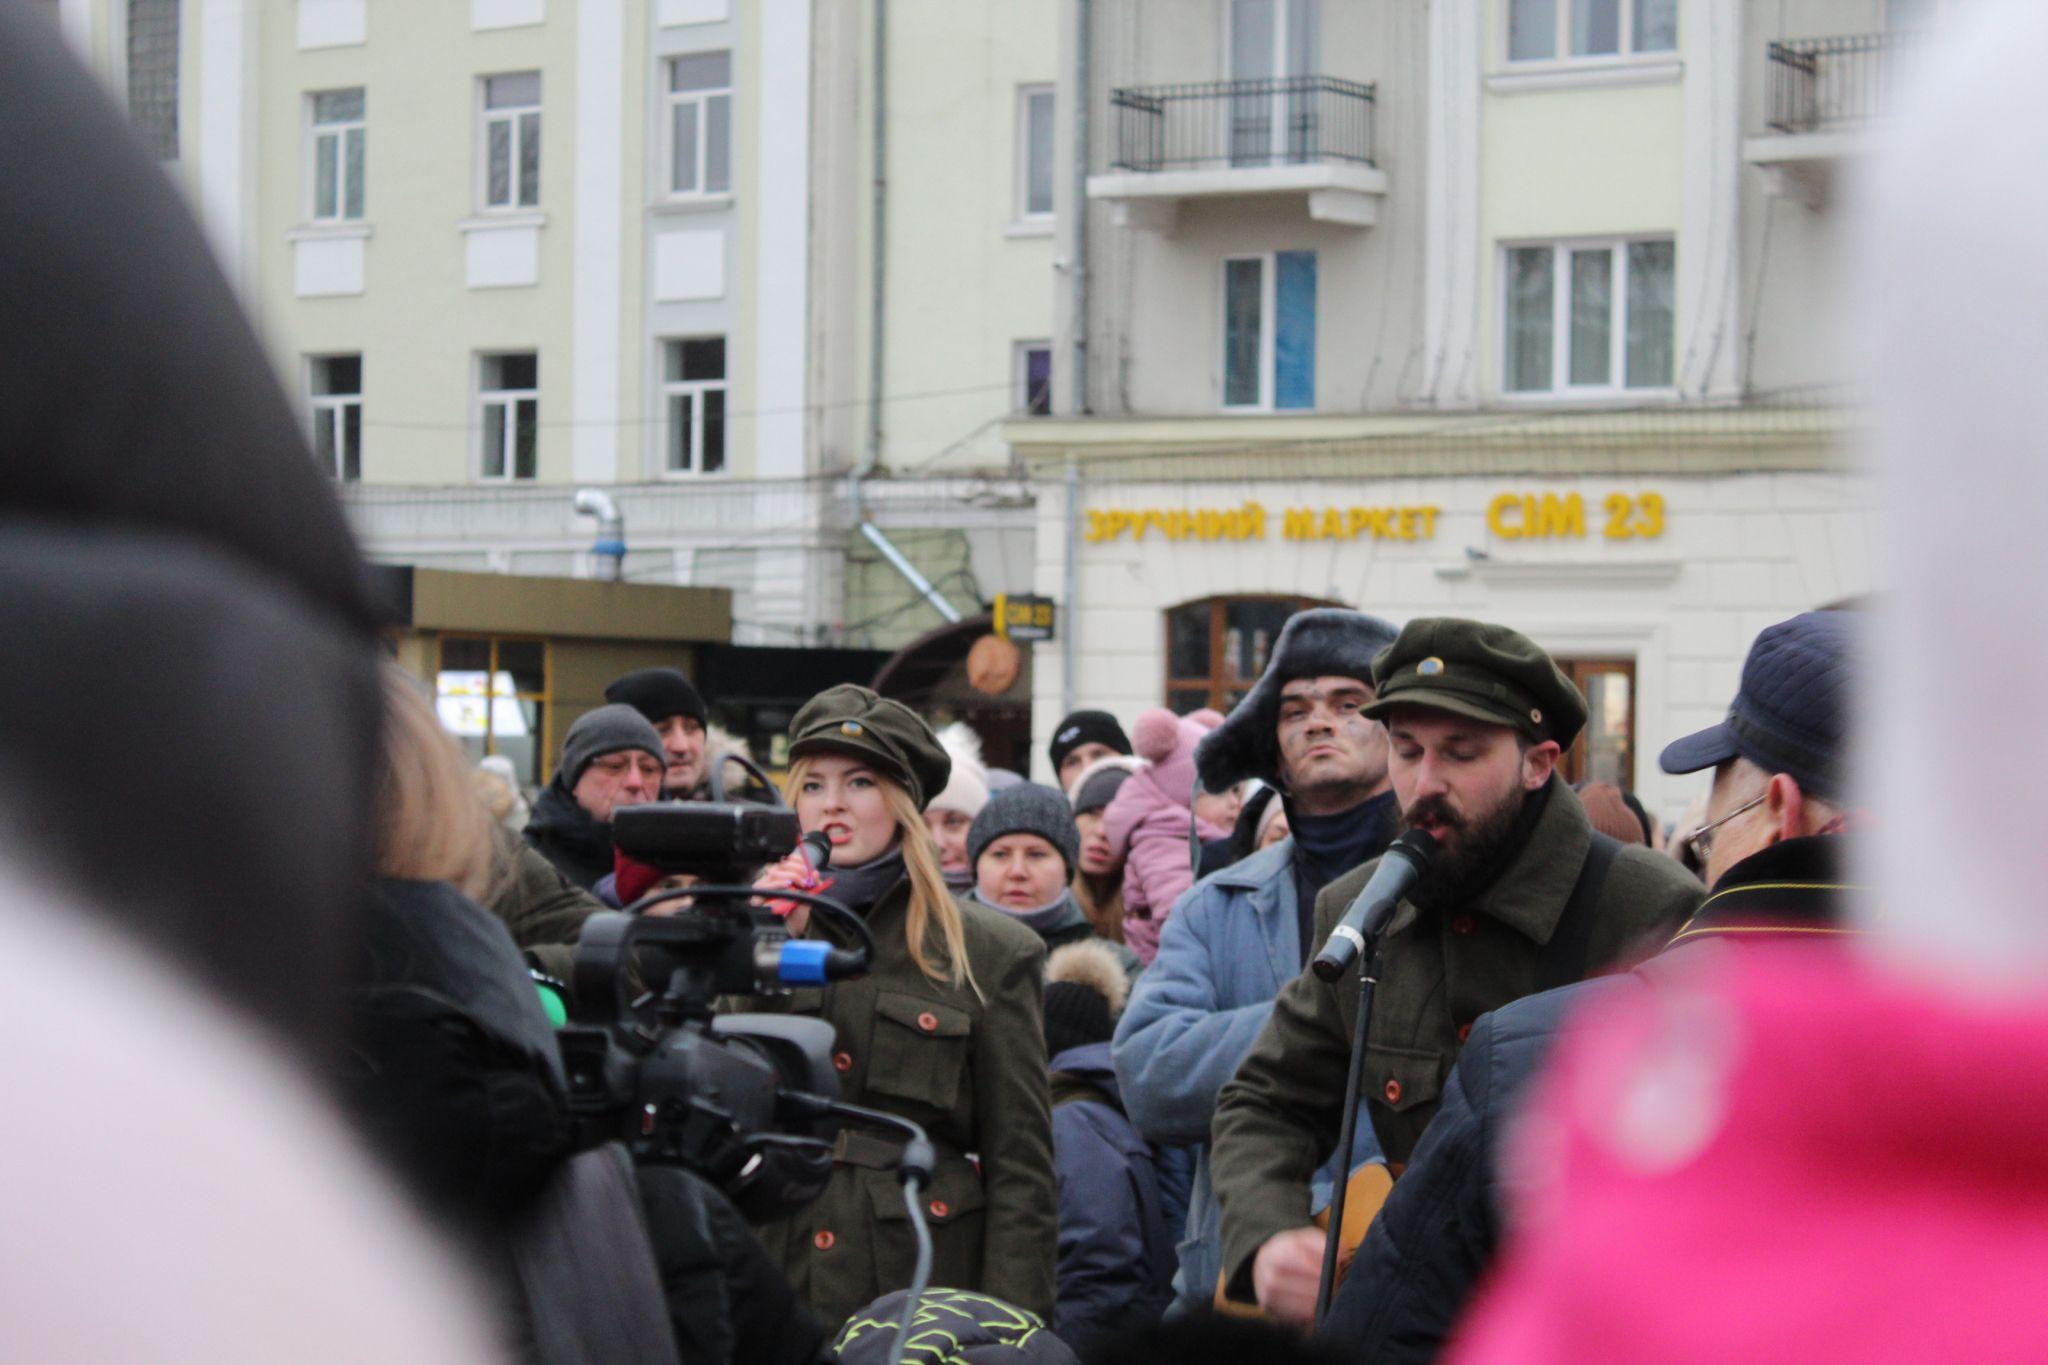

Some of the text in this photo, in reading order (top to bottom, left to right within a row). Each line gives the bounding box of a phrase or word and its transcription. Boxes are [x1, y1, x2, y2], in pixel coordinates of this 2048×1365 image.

[1084, 501, 1441, 543] ЗРУЧНИЙ МАРКЕТ
[1486, 491, 1666, 540] СІМ 23
